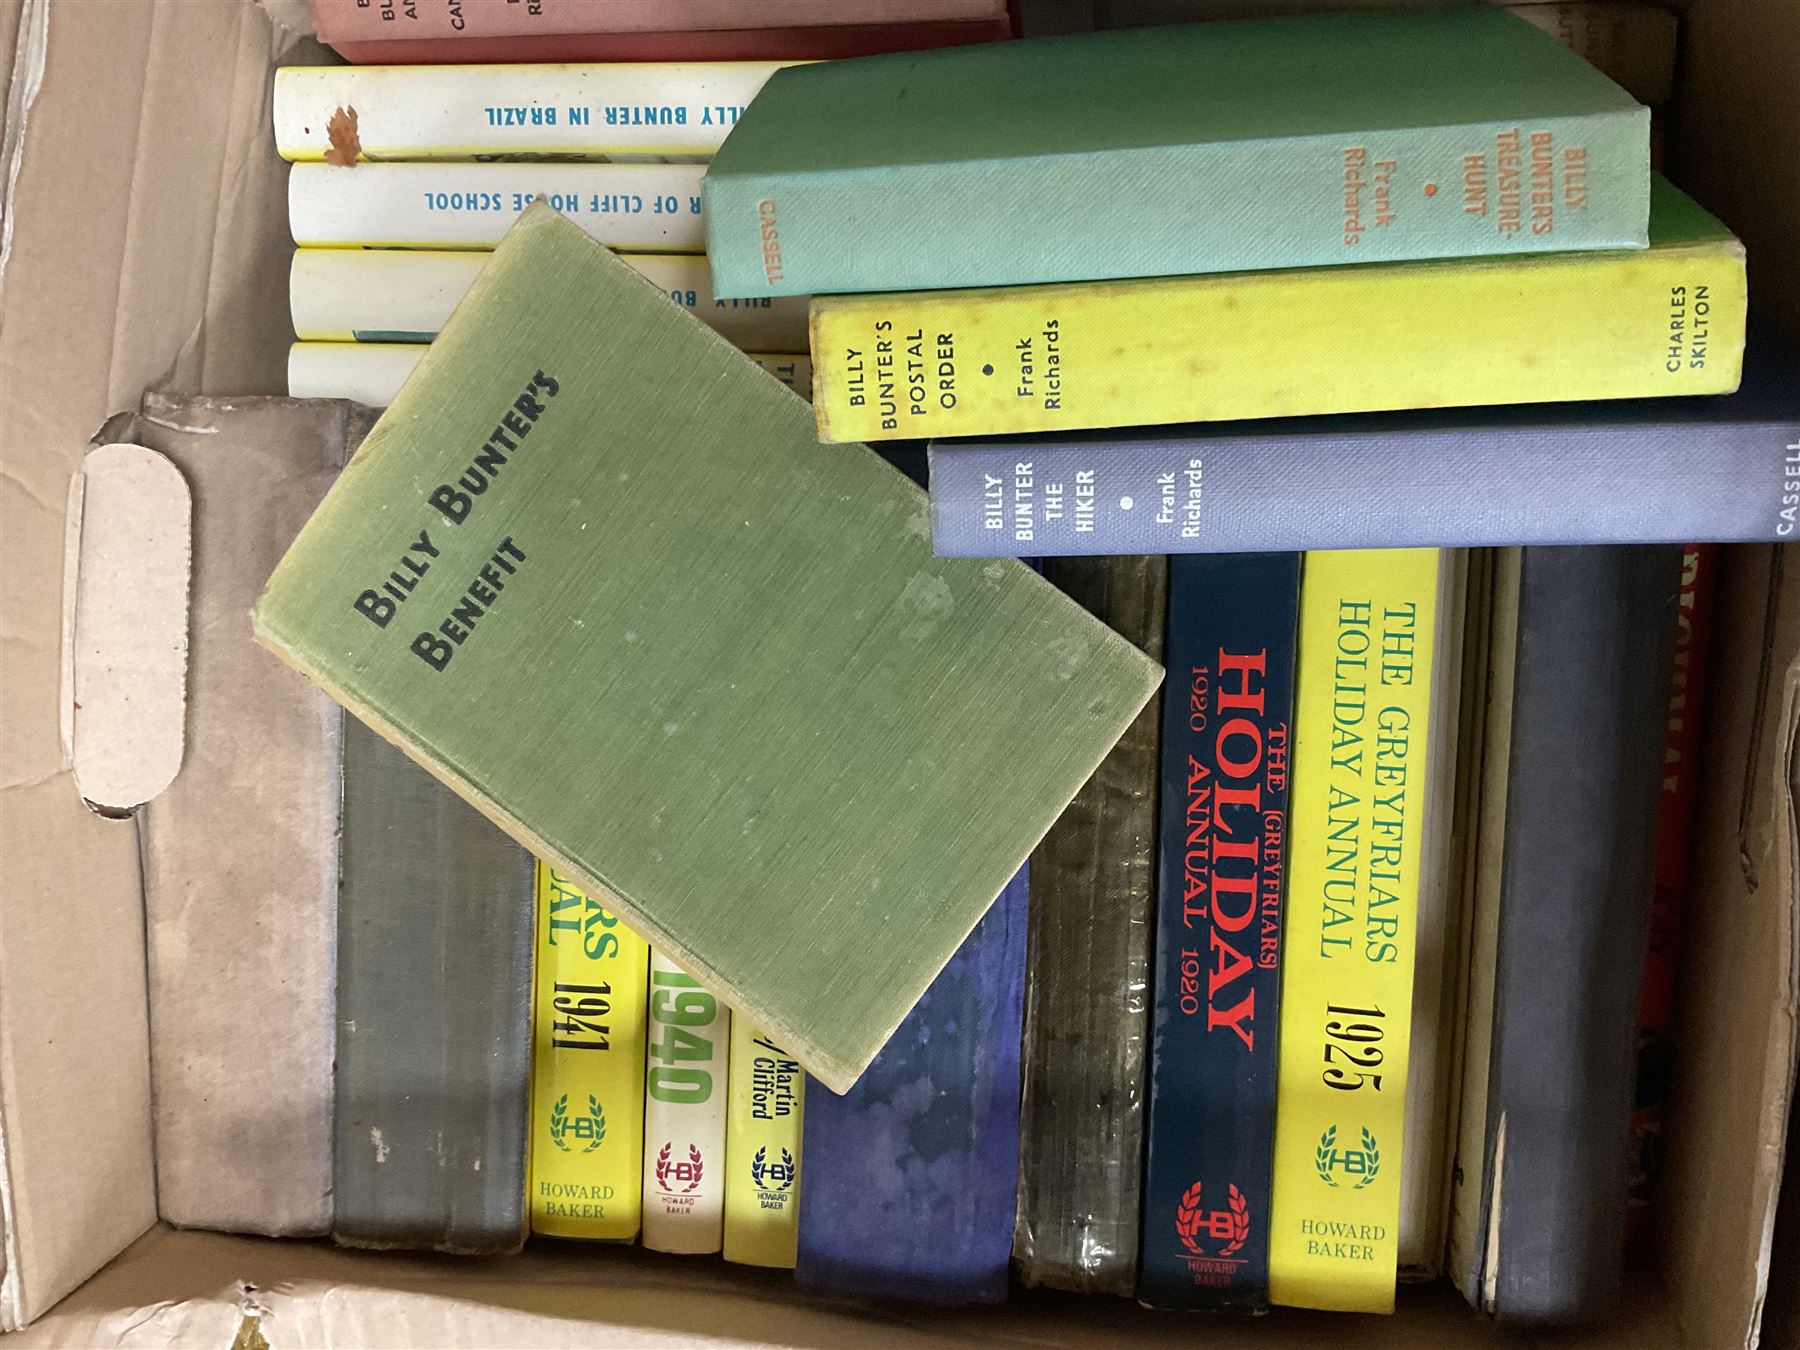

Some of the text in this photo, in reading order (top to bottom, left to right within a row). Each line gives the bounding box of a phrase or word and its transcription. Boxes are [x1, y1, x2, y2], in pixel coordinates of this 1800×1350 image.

[485, 107, 557, 126] BRAZIL
[568, 107, 589, 125] IN
[605, 106, 687, 126] BUNTER
[424, 191, 503, 211] SCHOOL
[590, 194, 643, 213] CLIFF
[653, 195, 679, 214] OF
[1343, 147, 1366, 246] Richards
[1373, 160, 1397, 227] Frank
[1463, 154, 1487, 217] HUNT
[1530, 131, 1554, 236] BUNTER'S
[1563, 147, 1586, 210] BILLY
[758, 199, 784, 285] CASSELL
[1666, 285, 1687, 373] CHARLES
[1690, 285, 1710, 369] SKILTON
[849, 348, 865, 407] BILLY
[876, 320, 898, 430] BUNTER'S
[906, 328, 927, 416] POSTAL
[937, 332, 957, 409] ORDER
[1017, 337, 1034, 398] Frank
[1045, 318, 1061, 411] Richards
[353, 368, 560, 630] BILLY BUNTER'S
[985, 474, 1004, 530] BILLY
[1015, 462, 1034, 541] BUNTER
[1046, 483, 1064, 522] THE
[1076, 469, 1095, 533] HIKER
[1156, 471, 1175, 525] Frank
[1182, 458, 1203, 538] Richards
[1776, 438, 1800, 535] CASSELL
[410, 536, 527, 673] BENEFIT
[1320, 598, 1372, 959] HOLIDAY ANNUAL
[1365, 602, 1417, 965] THE GREYFRIARS
[1180, 665, 1211, 1015] 1920 ANNUAL 1920
[1208, 647, 1267, 1052] HOLIDAY
[1257, 721, 1287, 969] THE (GREYFRIARS)
[552, 980, 612, 1052] 1941
[648, 970, 717, 1105] 1940
[1322, 1000, 1386, 1093] 1925
[753, 1057, 775, 1120] Clifford
[776, 1059, 799, 1116] Martin
[540, 1181, 614, 1200] HOWARD
[545, 1201, 605, 1218] BAKER
[757, 1192, 787, 1202] HOWARD
[761, 1201, 783, 1210] BAKER
[1300, 1219, 1386, 1241] HOWARD
[1307, 1240, 1375, 1261] BAKER
[1187, 1260, 1237, 1275] HOWARD
[1194, 1274, 1231, 1286] BAKER
